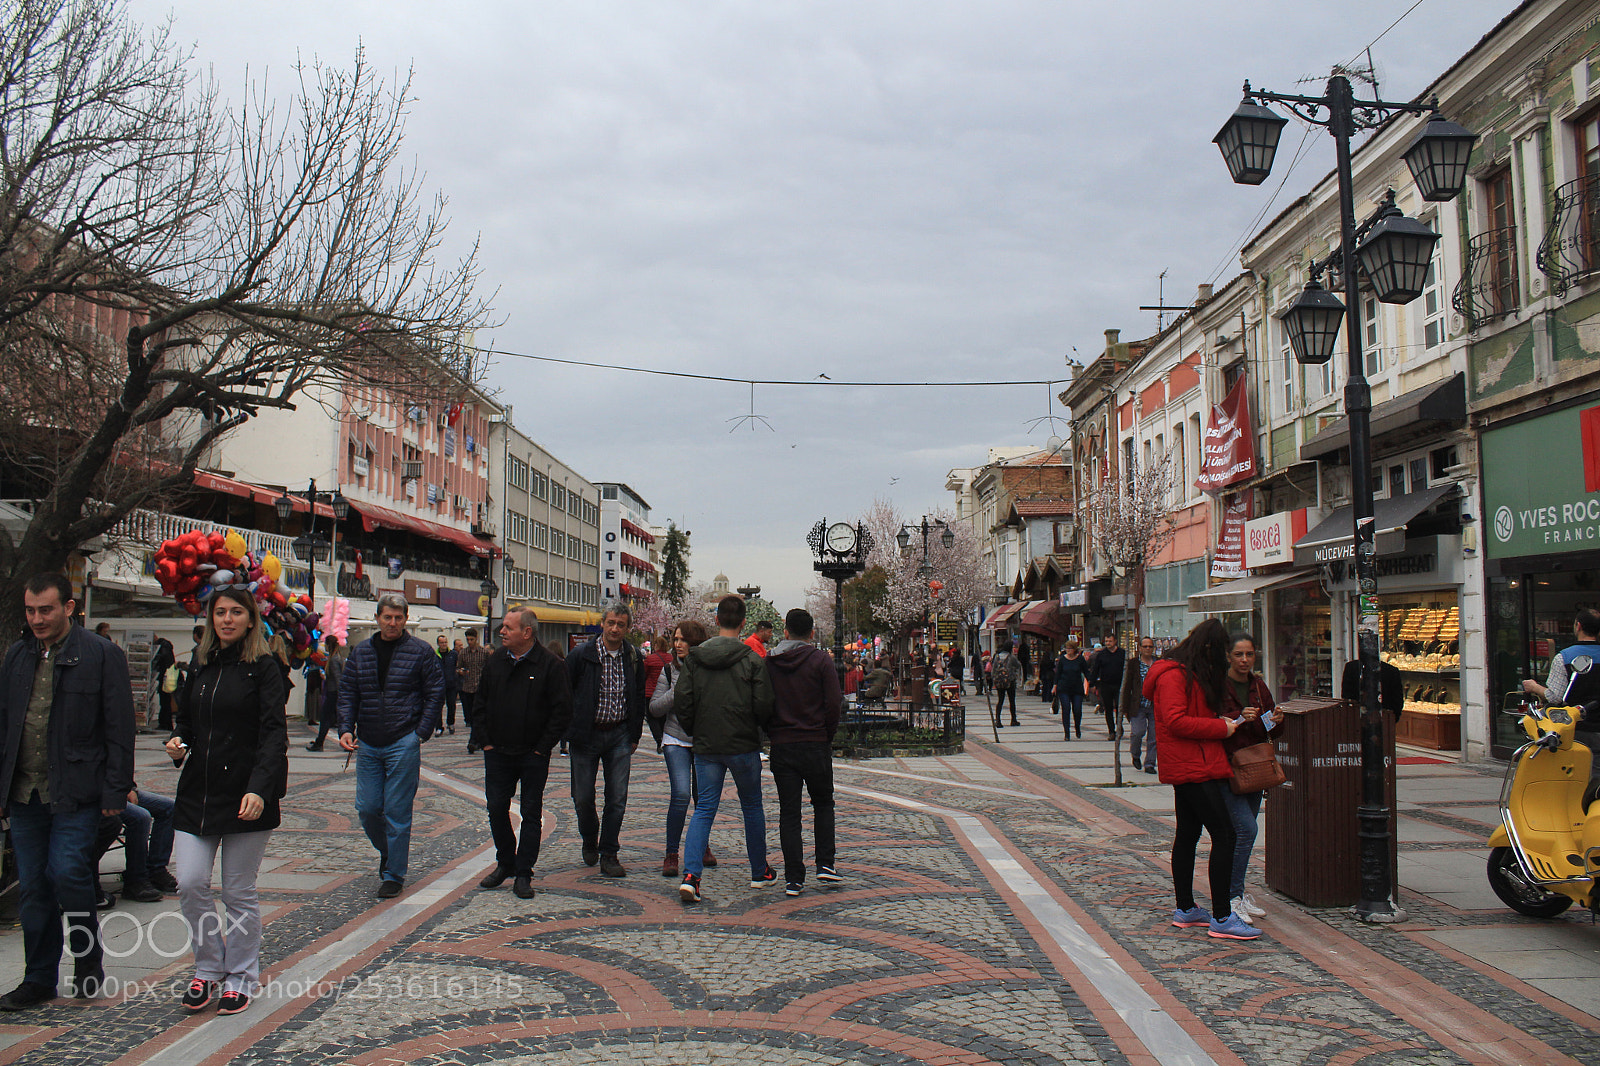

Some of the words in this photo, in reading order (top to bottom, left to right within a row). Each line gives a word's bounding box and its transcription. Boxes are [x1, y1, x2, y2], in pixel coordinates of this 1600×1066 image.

[1519, 506, 1557, 529] YVES
[1315, 543, 1356, 562] MÜCEVHE
[605, 532, 617, 598] OTEL
